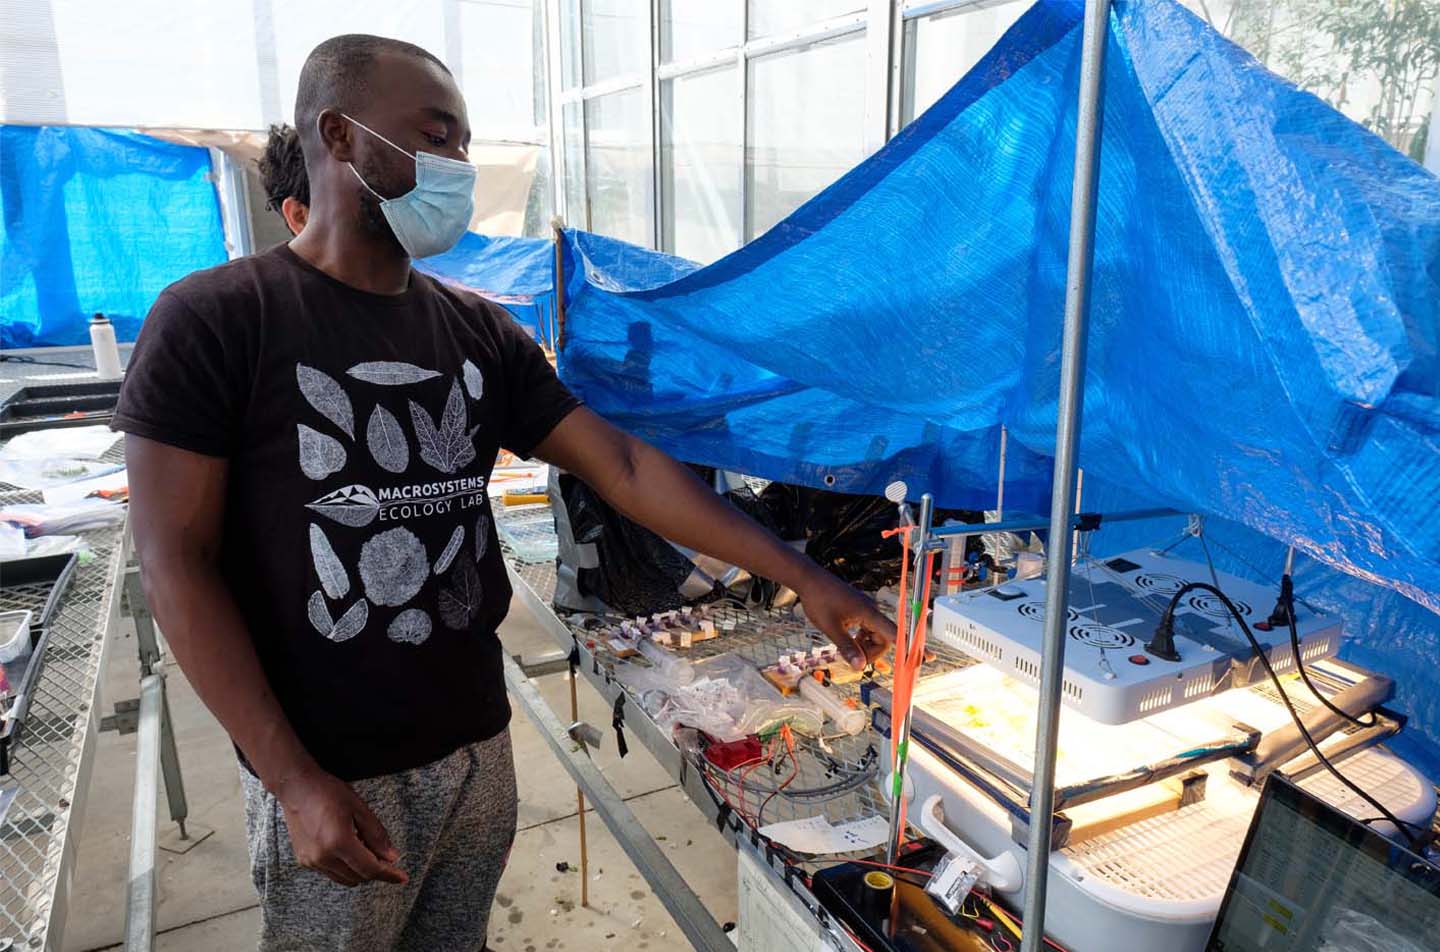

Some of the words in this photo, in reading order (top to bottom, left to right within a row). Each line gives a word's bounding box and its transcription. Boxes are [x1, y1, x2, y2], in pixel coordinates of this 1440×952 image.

[378, 476, 485, 500] MACROSYSTEMS
[379, 500, 452, 521] ECOLOGY
[460, 494, 483, 509] LAB
